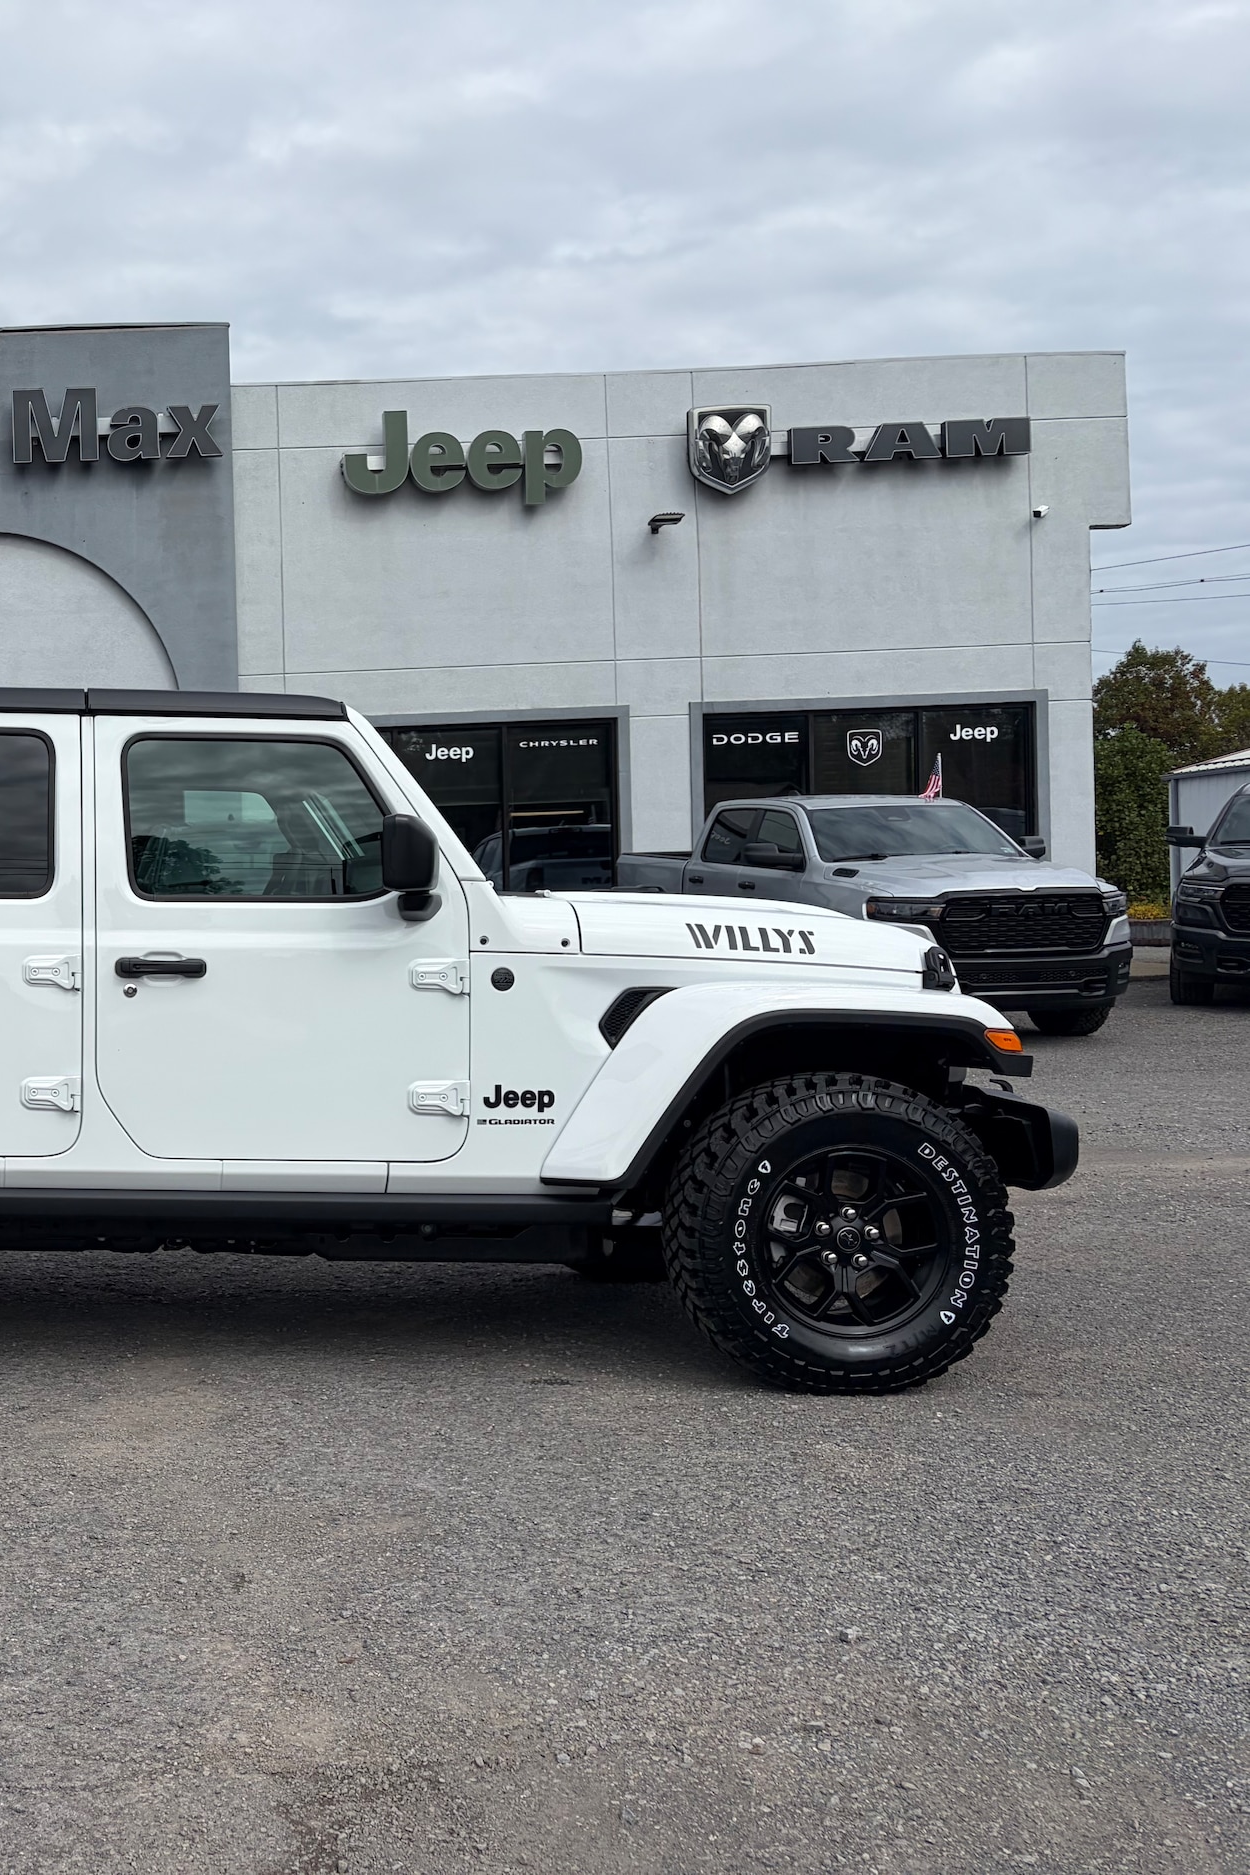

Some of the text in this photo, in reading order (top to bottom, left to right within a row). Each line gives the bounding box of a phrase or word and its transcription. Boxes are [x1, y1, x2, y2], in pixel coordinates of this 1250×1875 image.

[11, 387, 224, 464] Max
[787, 416, 1031, 465] RAM
[340, 410, 583, 505] Jeep
[519, 738, 598, 748] CHRYSLER
[712, 731, 799, 745] DODGE
[949, 724, 999, 743] Jeep
[425, 743, 474, 763] Jeep
[991, 903, 1068, 916] RAM
[685, 922, 816, 955] WILLYS
[483, 1084, 555, 1113] Jeep
[488, 1118, 555, 1126] GLADIATOR
[917, 1141, 982, 1308] DESTINATION
